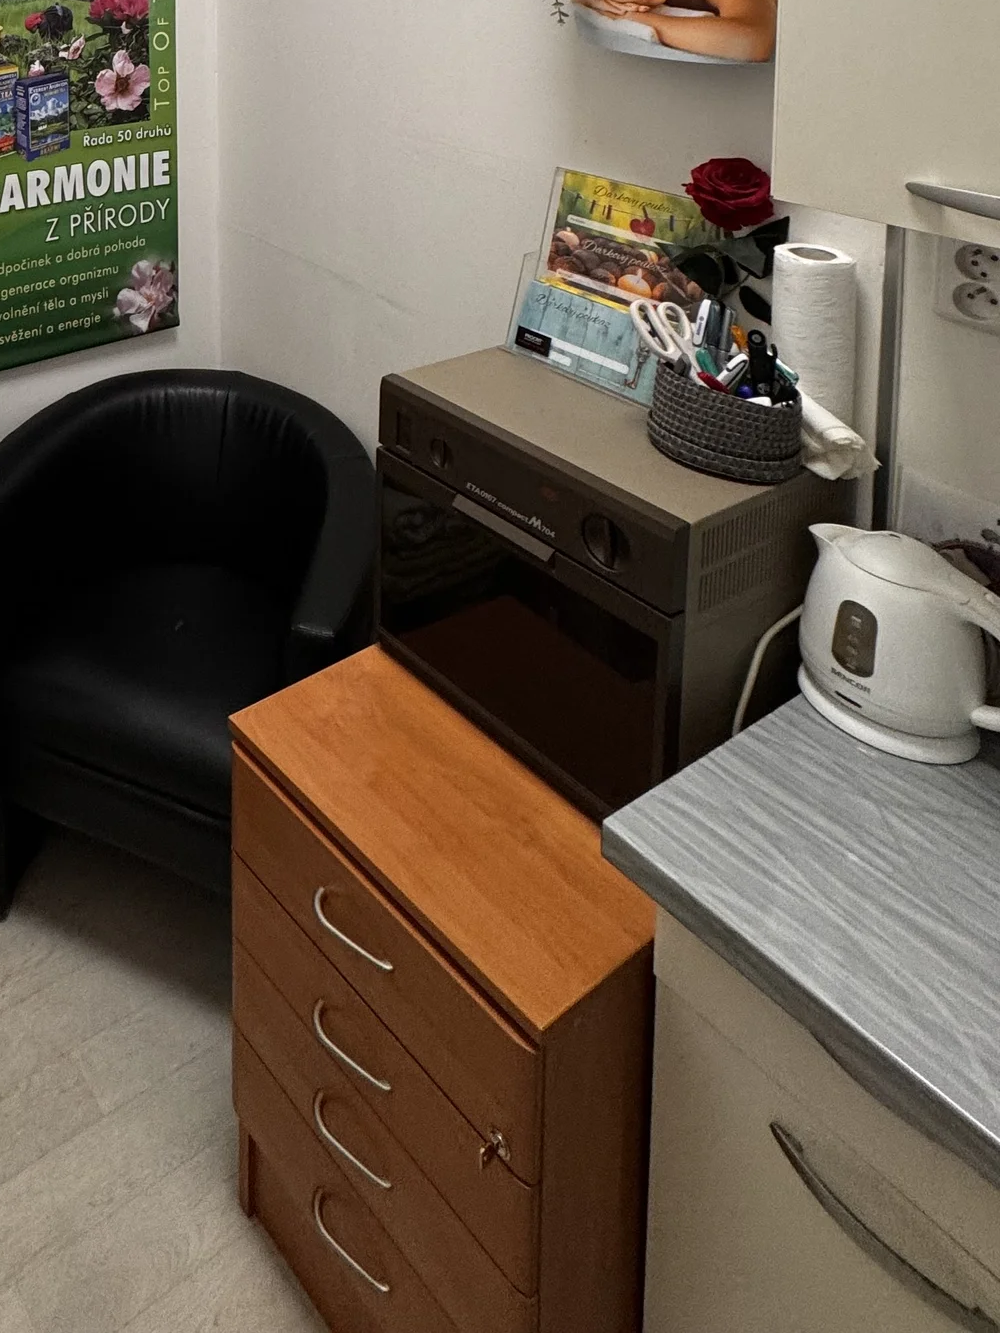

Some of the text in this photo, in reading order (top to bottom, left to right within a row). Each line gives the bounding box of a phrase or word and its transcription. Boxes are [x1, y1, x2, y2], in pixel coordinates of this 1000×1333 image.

[153, 17, 170, 51] OF
[153, 66, 170, 111] TOP
[83, 125, 172, 148] Řada 50 druhů
[45, 197, 171, 243] Z PŘÍRODY
[55, 253, 63, 264] a
[66, 242, 101, 262] dobrá
[104, 236, 146, 256] pohoda
[60, 265, 119, 289] organizmu
[44, 295, 66, 314] těla
[69, 296, 77, 307] a
[81, 287, 109, 307] mysli
[46, 324, 54, 335] a
[58, 313, 101, 334] energie
